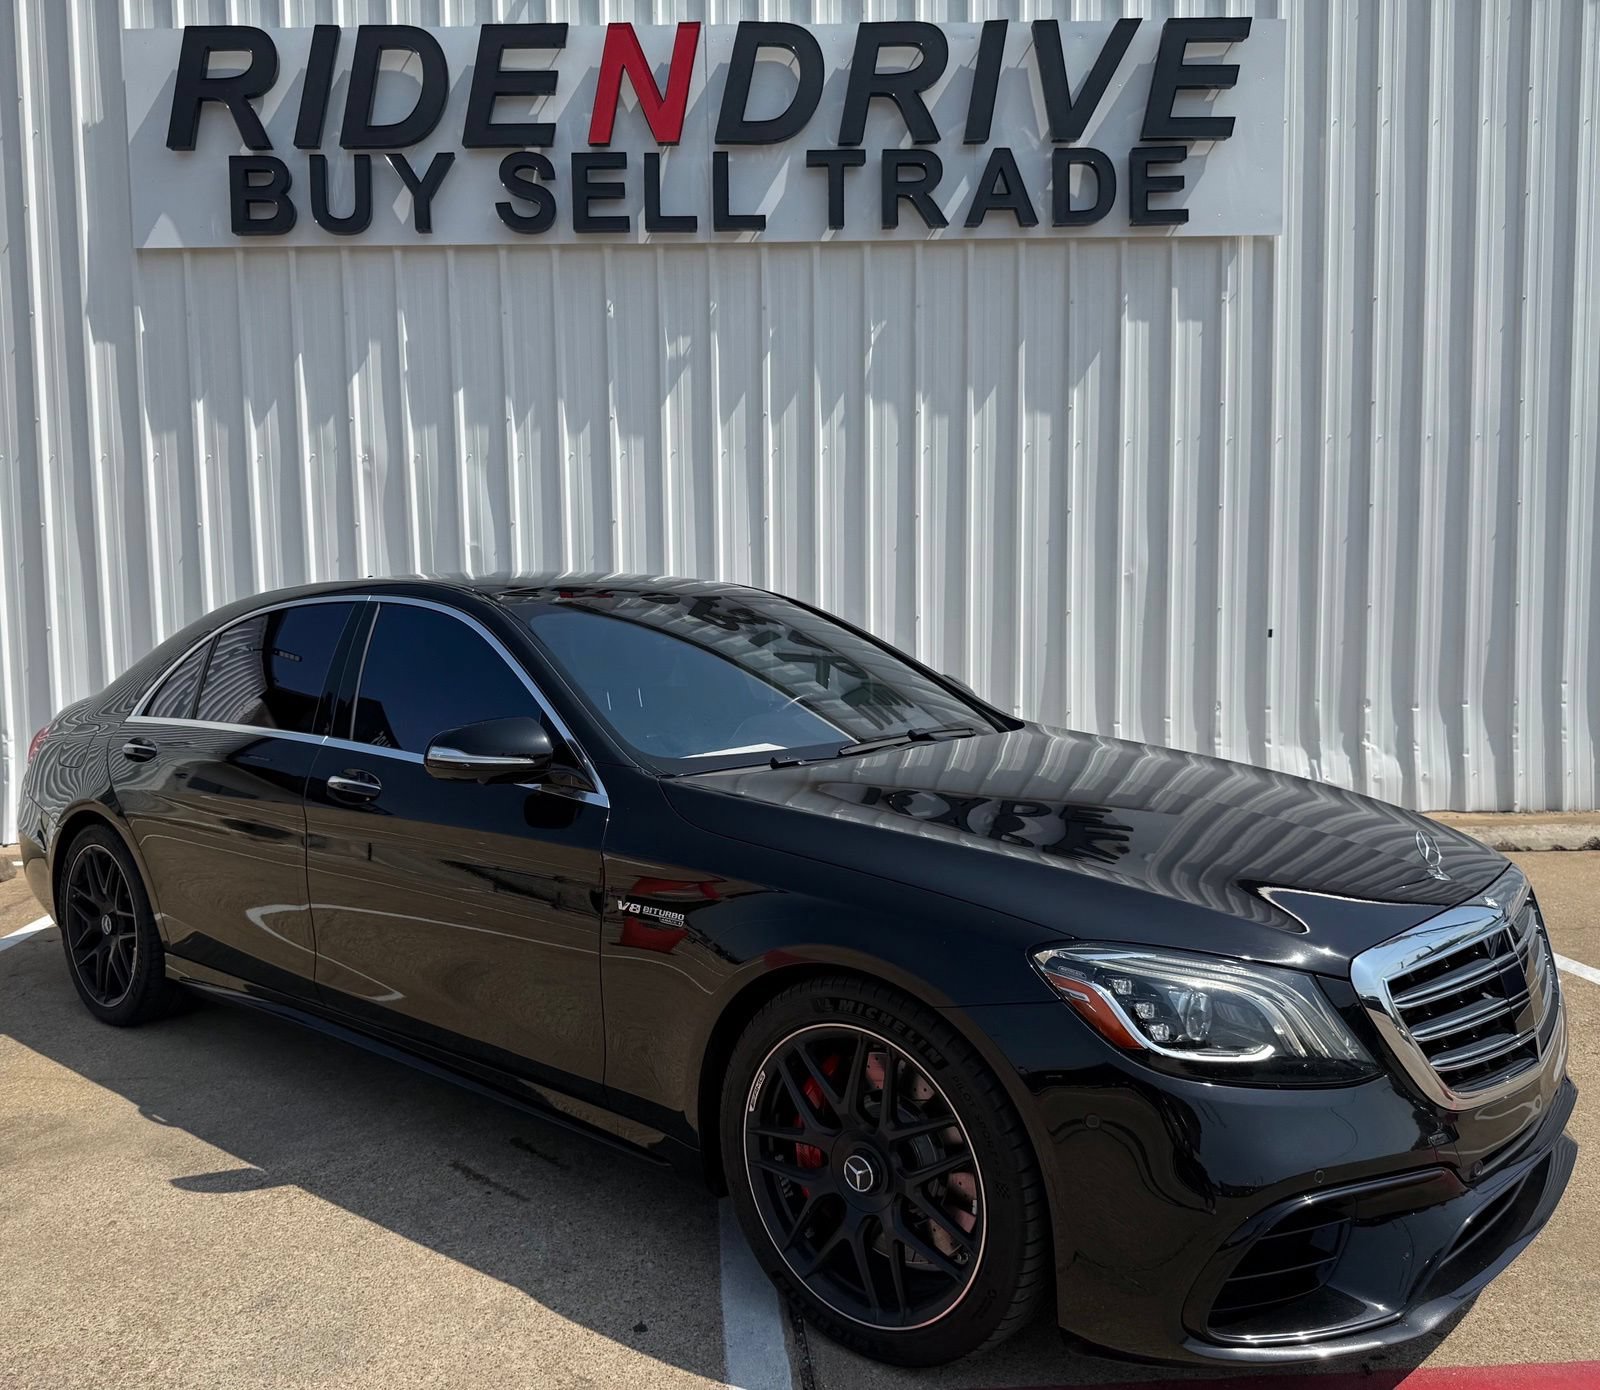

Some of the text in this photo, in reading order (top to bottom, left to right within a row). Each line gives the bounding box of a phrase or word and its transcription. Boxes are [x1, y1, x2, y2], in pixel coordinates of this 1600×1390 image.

[228, 145, 1190, 236] BUY SELL TRADE
[617, 900, 685, 920] V8 BITURBO
[838, 999, 945, 1066] MICHELIN
